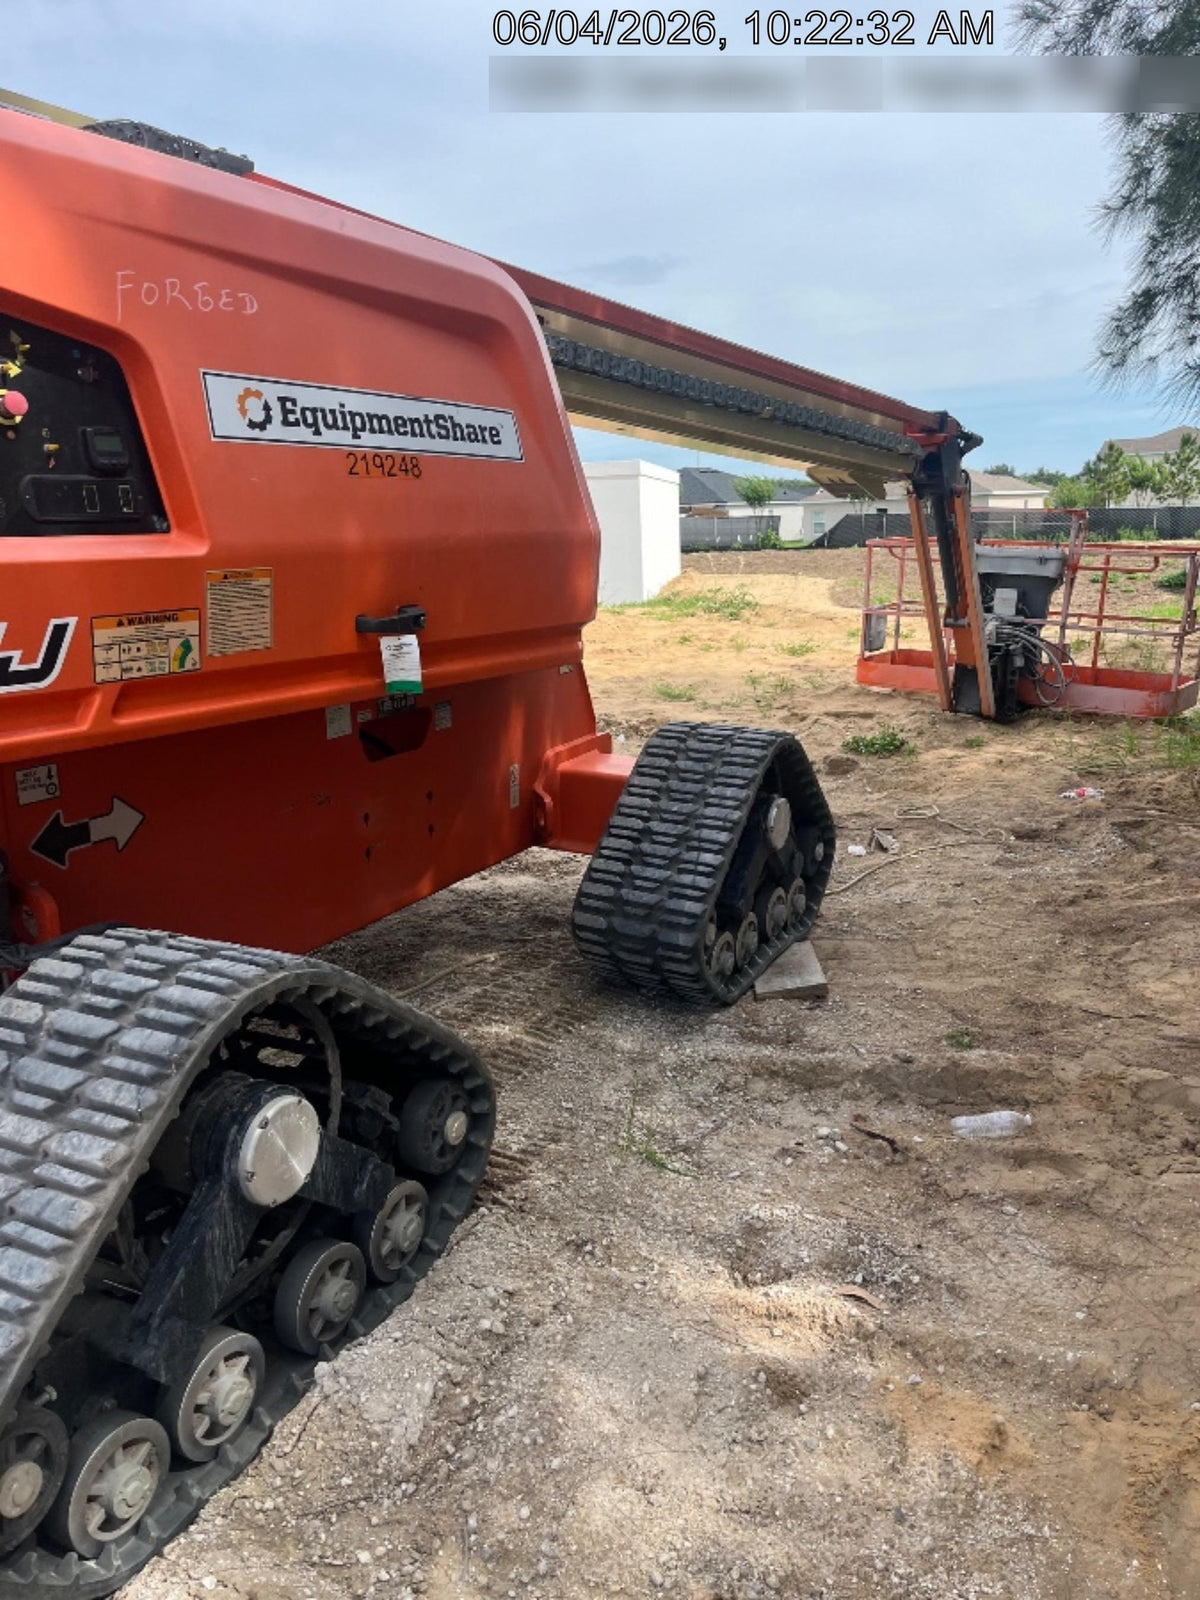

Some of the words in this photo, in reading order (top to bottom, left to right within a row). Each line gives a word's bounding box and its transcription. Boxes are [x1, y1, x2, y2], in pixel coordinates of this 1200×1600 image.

[115, 269, 259, 324] FORGED
[277, 396, 502, 445] EquipmentShare
[346, 452, 422, 479] 219248
[127, 613, 178, 626] WARNING
